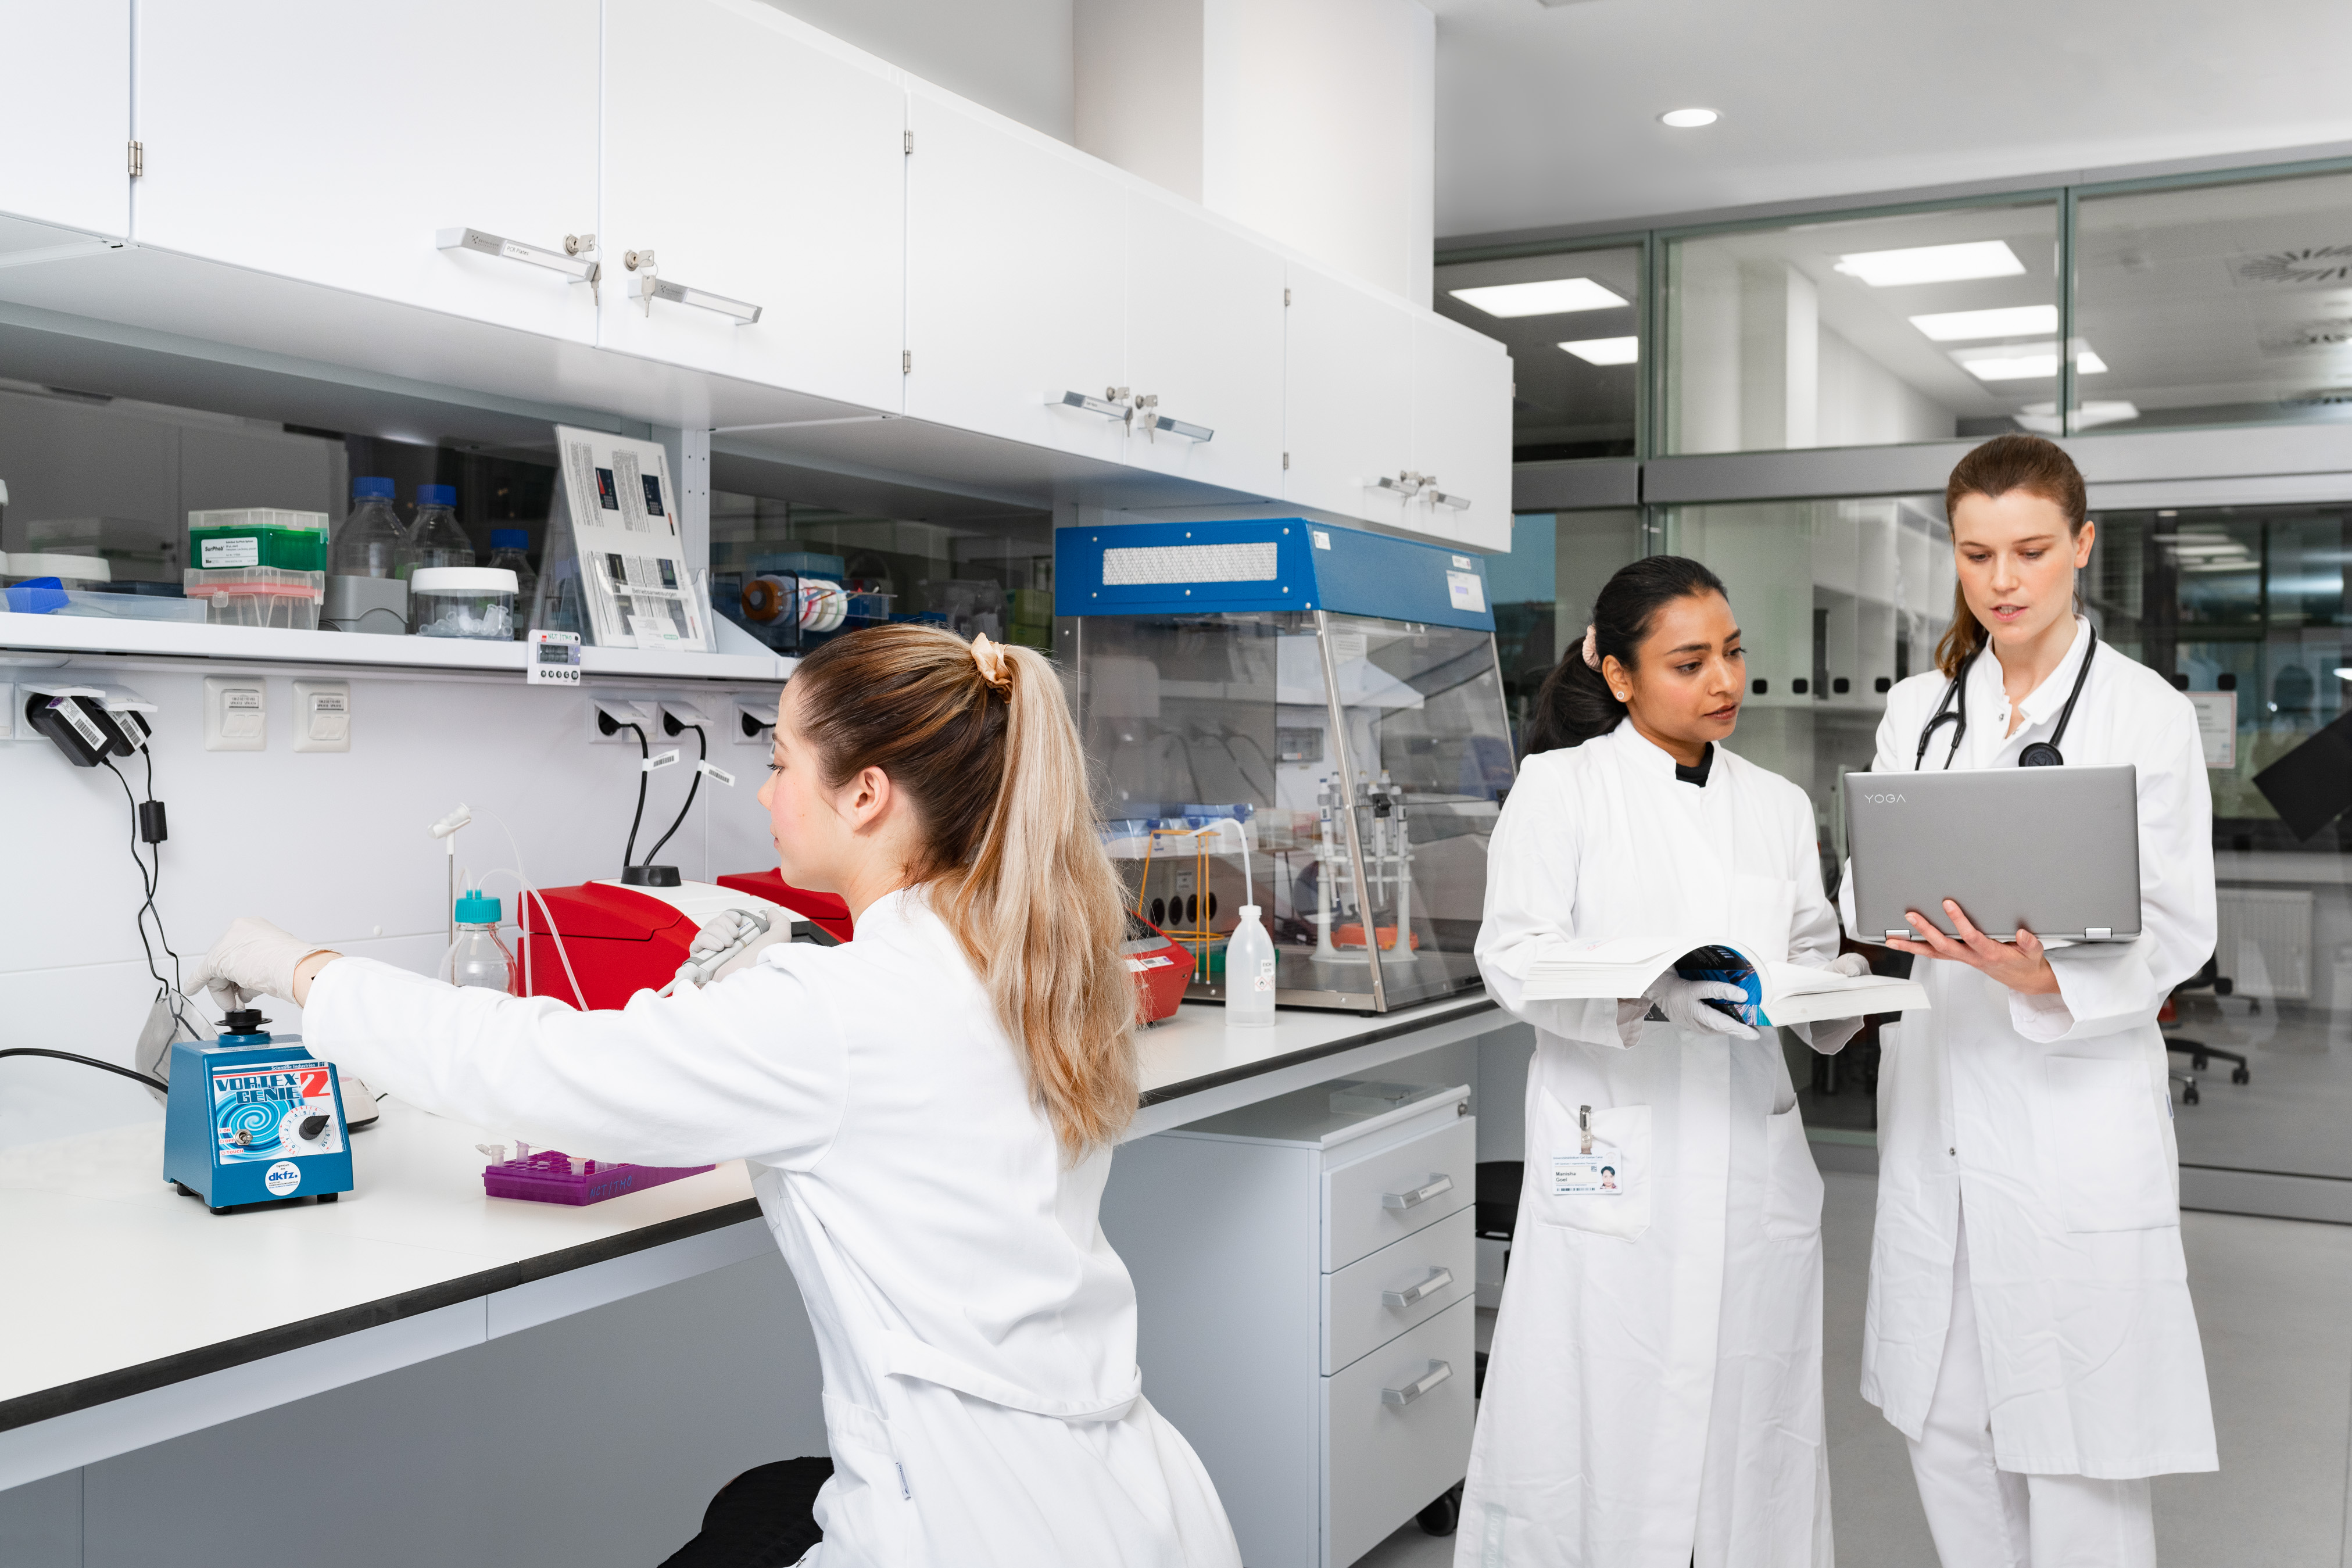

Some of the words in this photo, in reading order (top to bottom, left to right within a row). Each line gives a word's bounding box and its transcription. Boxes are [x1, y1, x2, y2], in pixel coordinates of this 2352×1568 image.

[1864, 794, 1906, 803] YOGA
[300, 1071, 331, 1098] 2
[236, 1086, 300, 1104] GENIE
[269, 1170, 298, 1181] dkfz.
